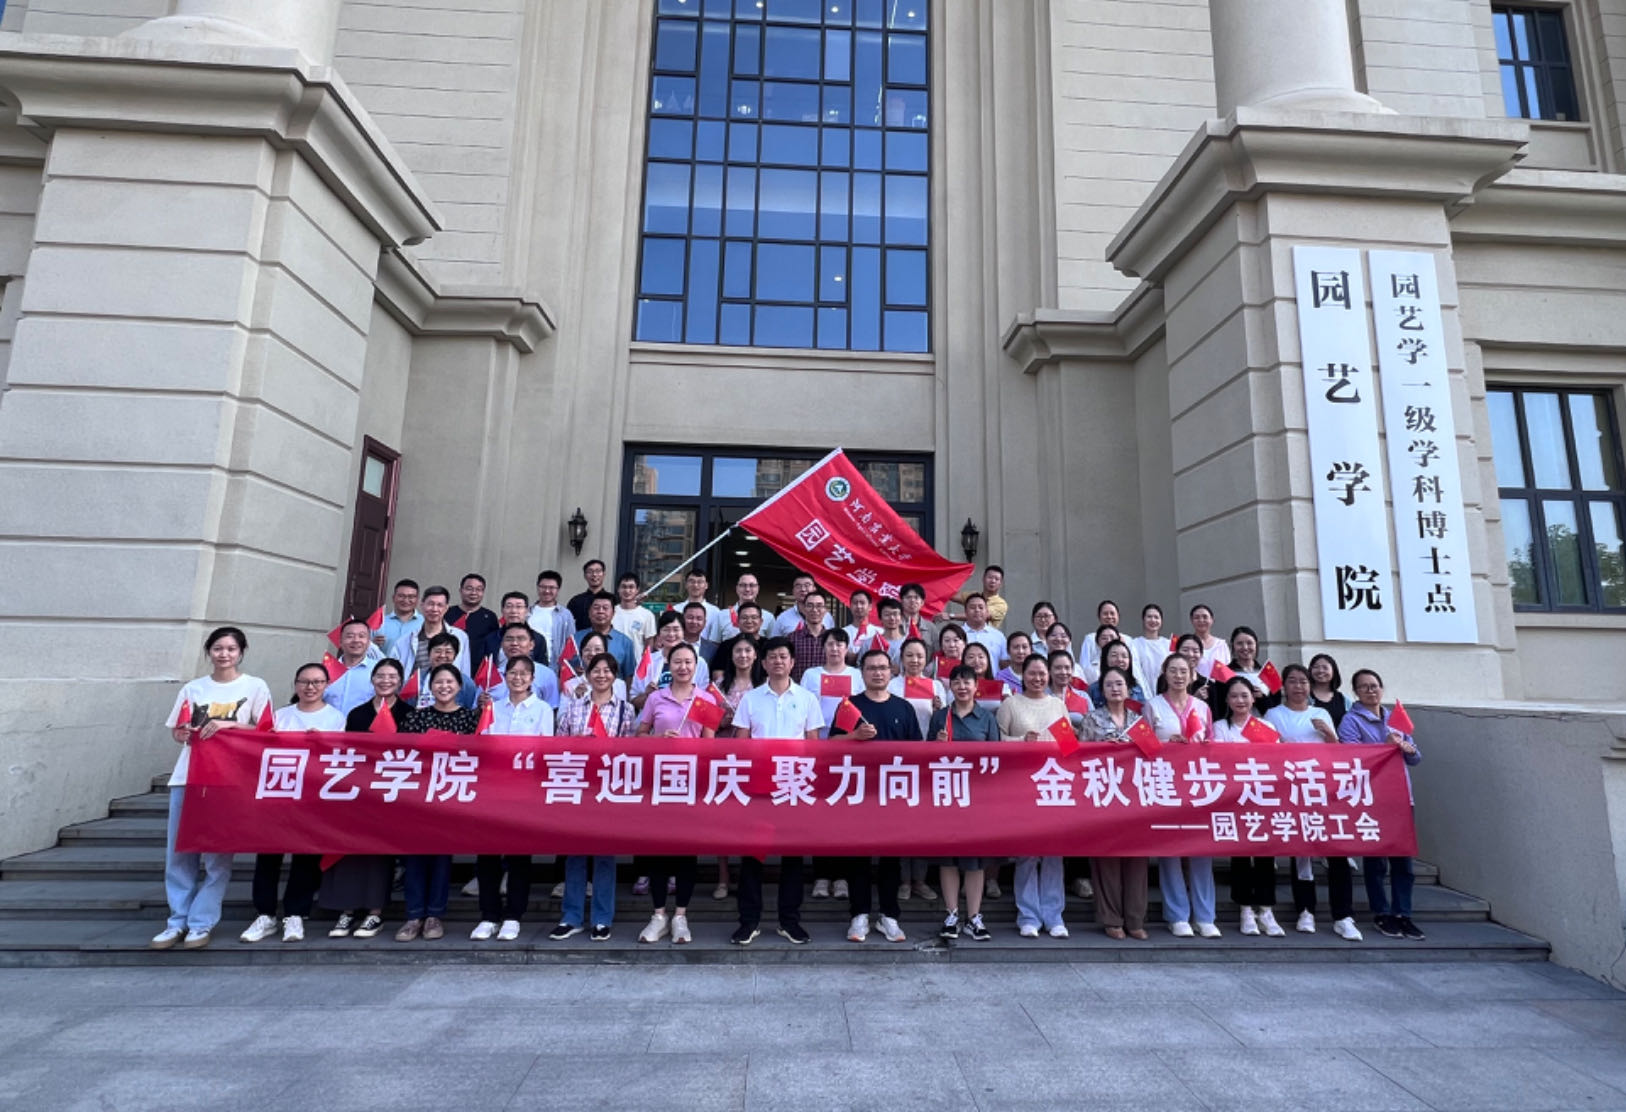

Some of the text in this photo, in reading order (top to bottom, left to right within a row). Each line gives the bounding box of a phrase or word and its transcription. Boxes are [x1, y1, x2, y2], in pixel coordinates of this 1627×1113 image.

[1311, 270, 1383, 611] 园艺学院
[1390, 273, 1456, 613] 园艺学一级学科博士点
[255, 748, 1374, 808] 园艺学院 “喜迎国庆 聚力向前” 金秋健步走活动
